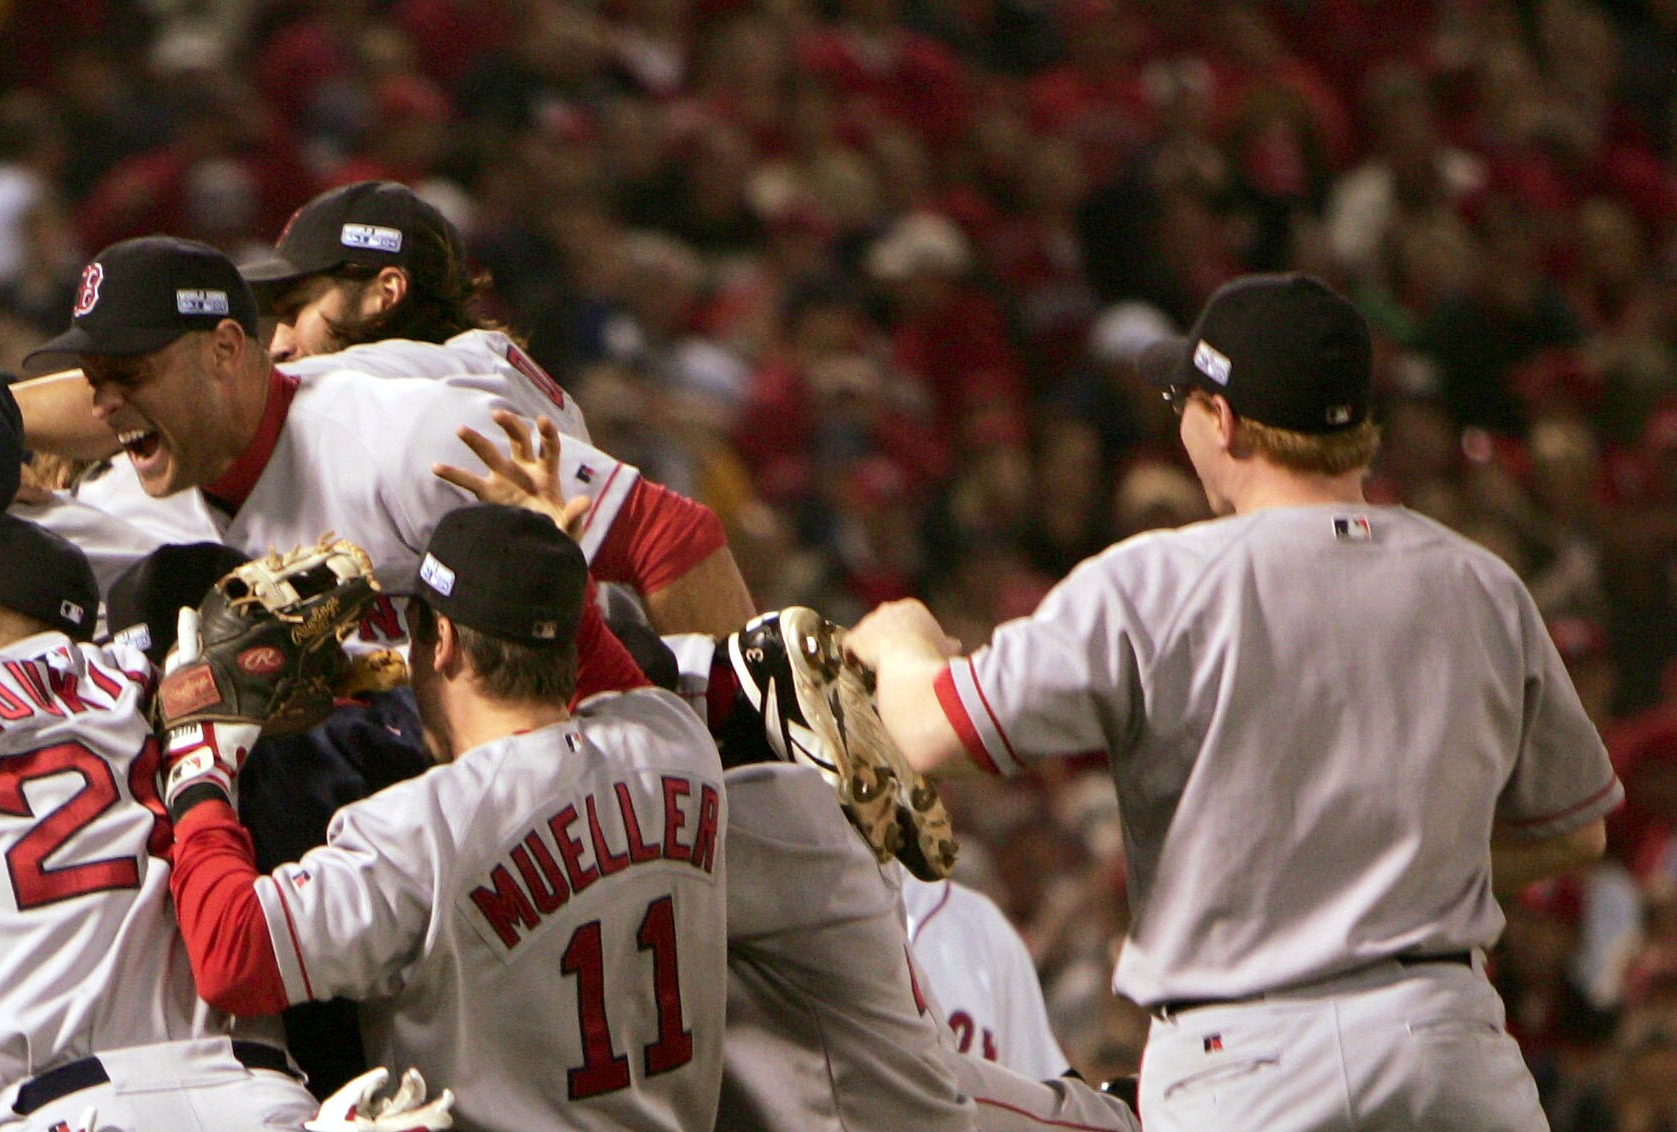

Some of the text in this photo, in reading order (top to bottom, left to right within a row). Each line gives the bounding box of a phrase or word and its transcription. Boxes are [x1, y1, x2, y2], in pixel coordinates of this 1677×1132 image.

[73, 262, 104, 318] B
[469, 775, 719, 950] MUELLER
[560, 892, 694, 1101] 11
